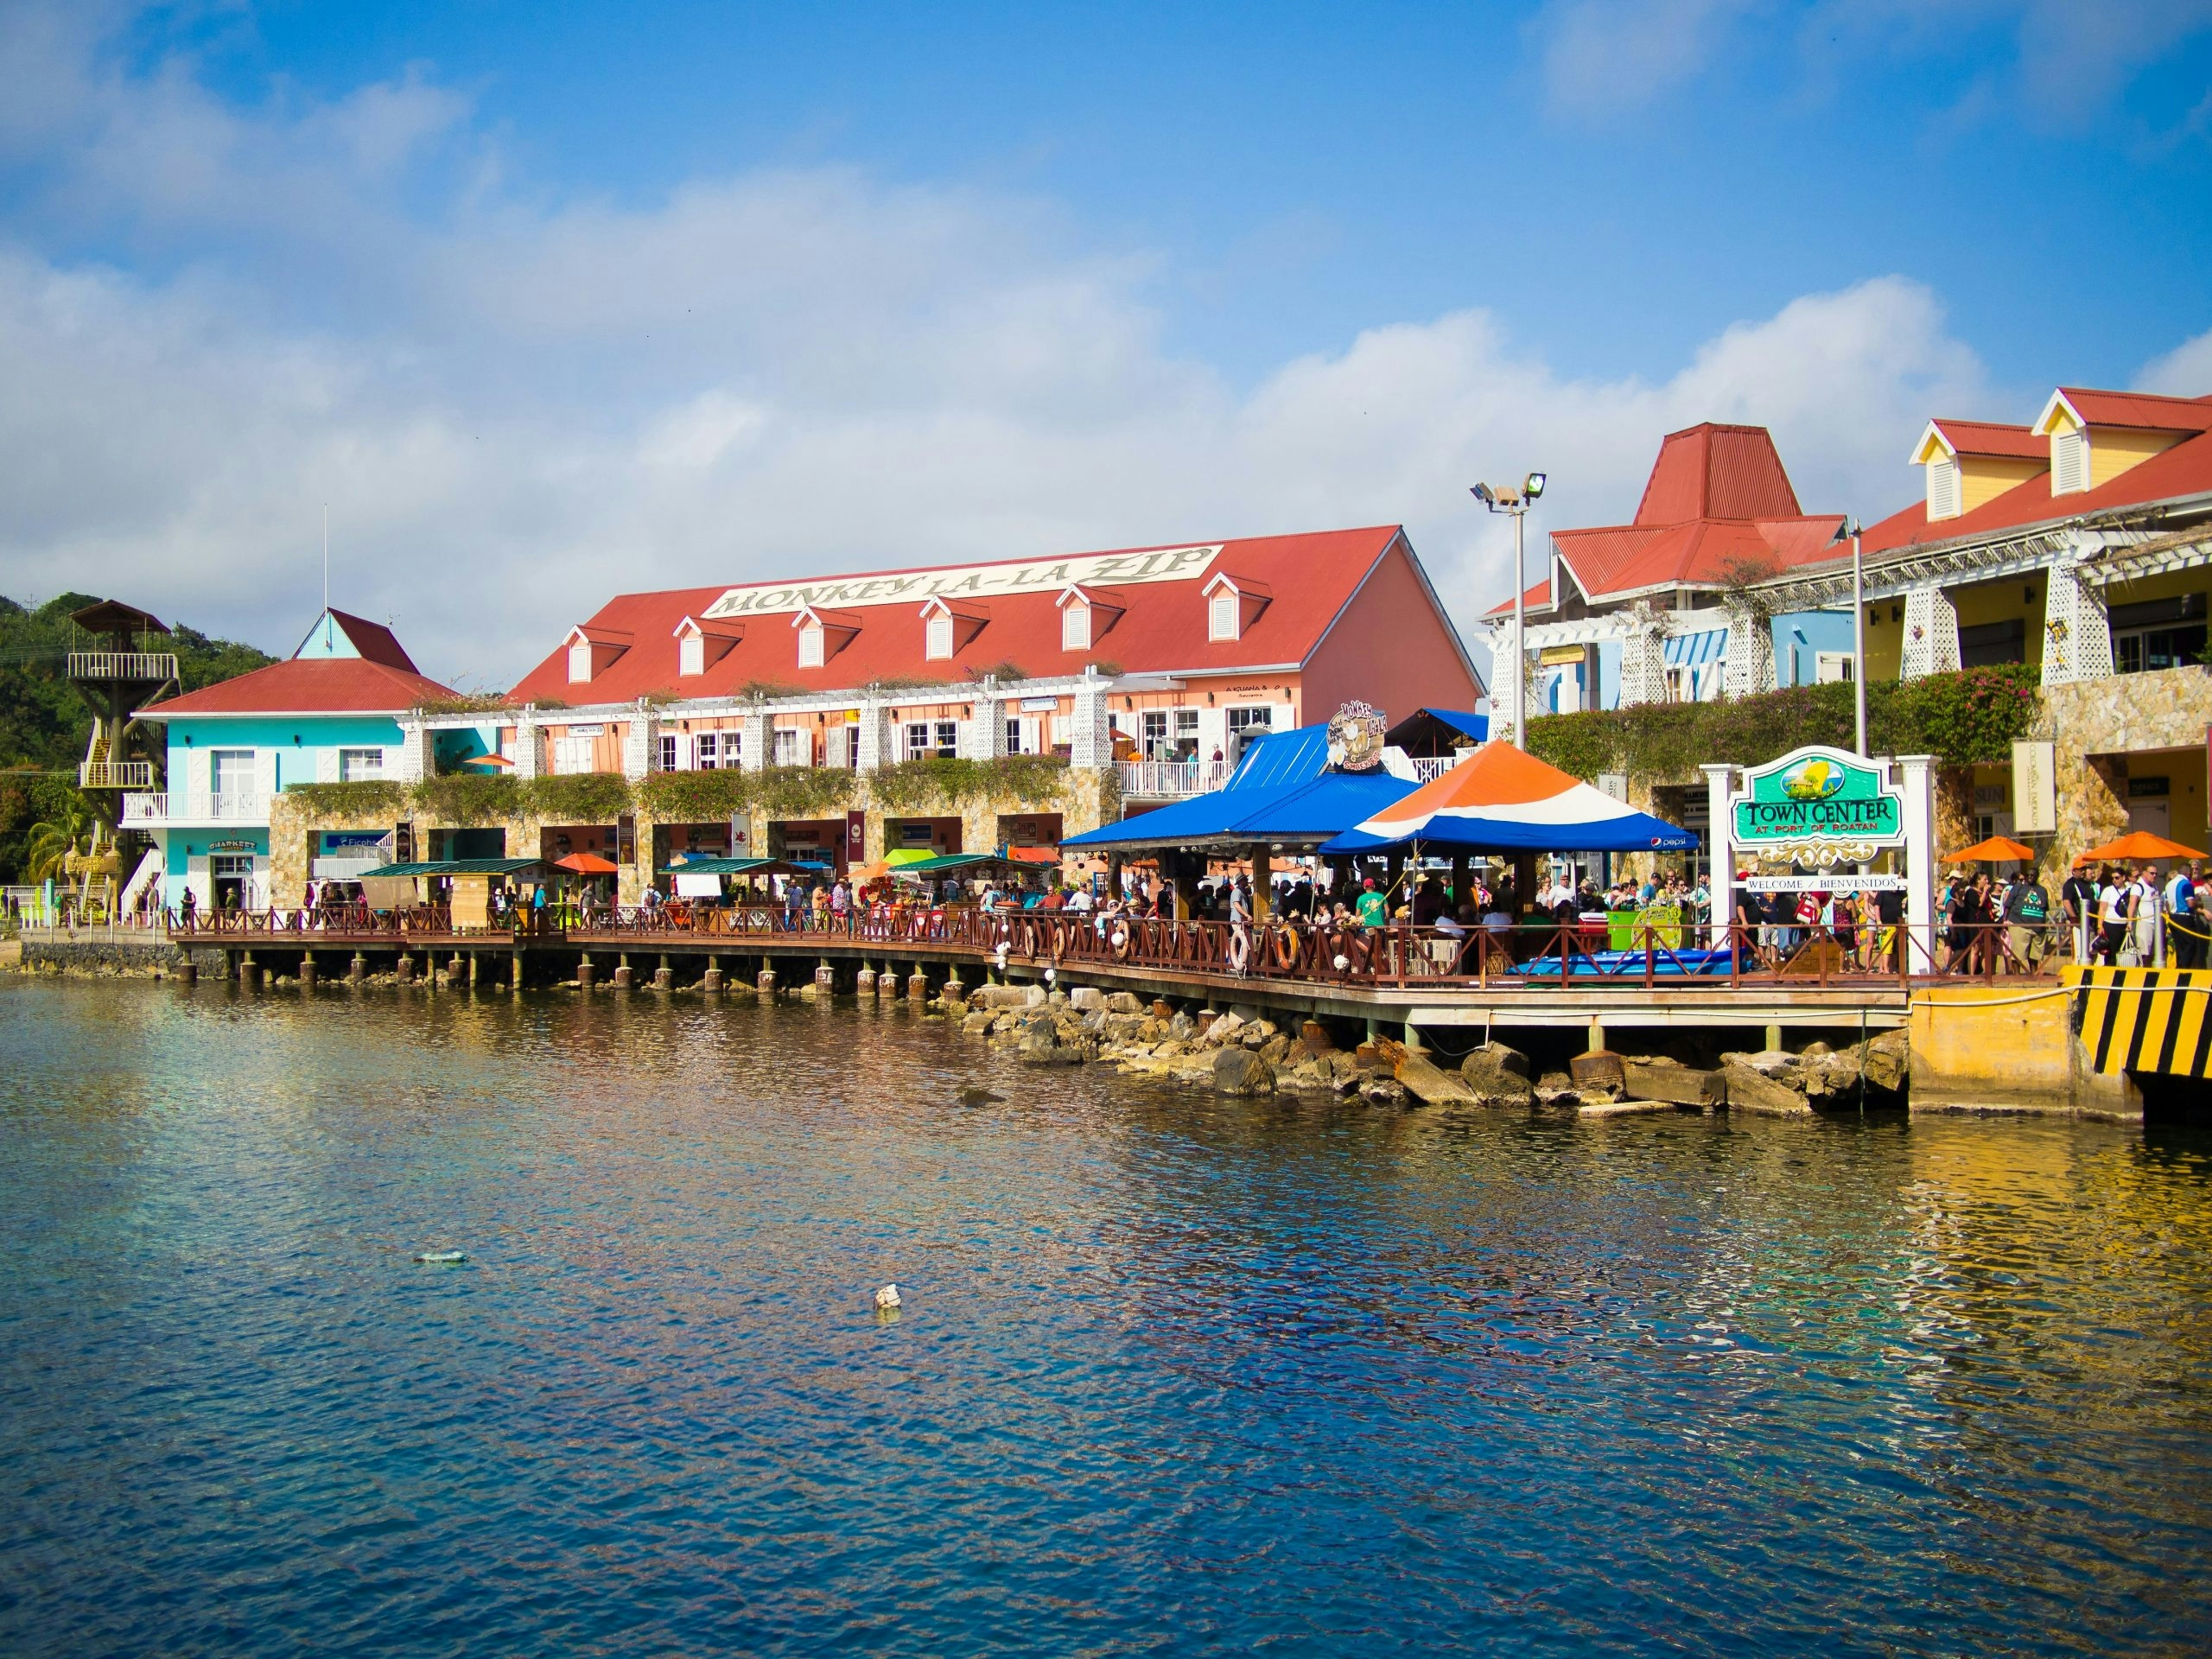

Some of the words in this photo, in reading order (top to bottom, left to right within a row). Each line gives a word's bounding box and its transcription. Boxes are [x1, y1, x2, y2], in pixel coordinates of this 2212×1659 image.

[707, 575, 928, 615] MONKEY
[921, 563, 1070, 596] LA-LA
[1075, 547, 1213, 585] ZIP
[1341, 700, 1373, 720] MONKEY
[1745, 803, 1807, 825] TOWN
[1812, 801, 1893, 823] CENTER
[1755, 825, 1769, 834] AT
[1775, 824, 1804, 833] PORT
[1811, 823, 1826, 832] OF
[1833, 823, 1878, 831] ROATAN
[208, 840, 257, 851] SHARKEEZ
[348, 837, 378, 846] Ficohs
[1662, 837, 1686, 847] pepsi
[1749, 880, 1803, 889] WELCOME
[1820, 878, 1897, 888] BIENVENIDOS
